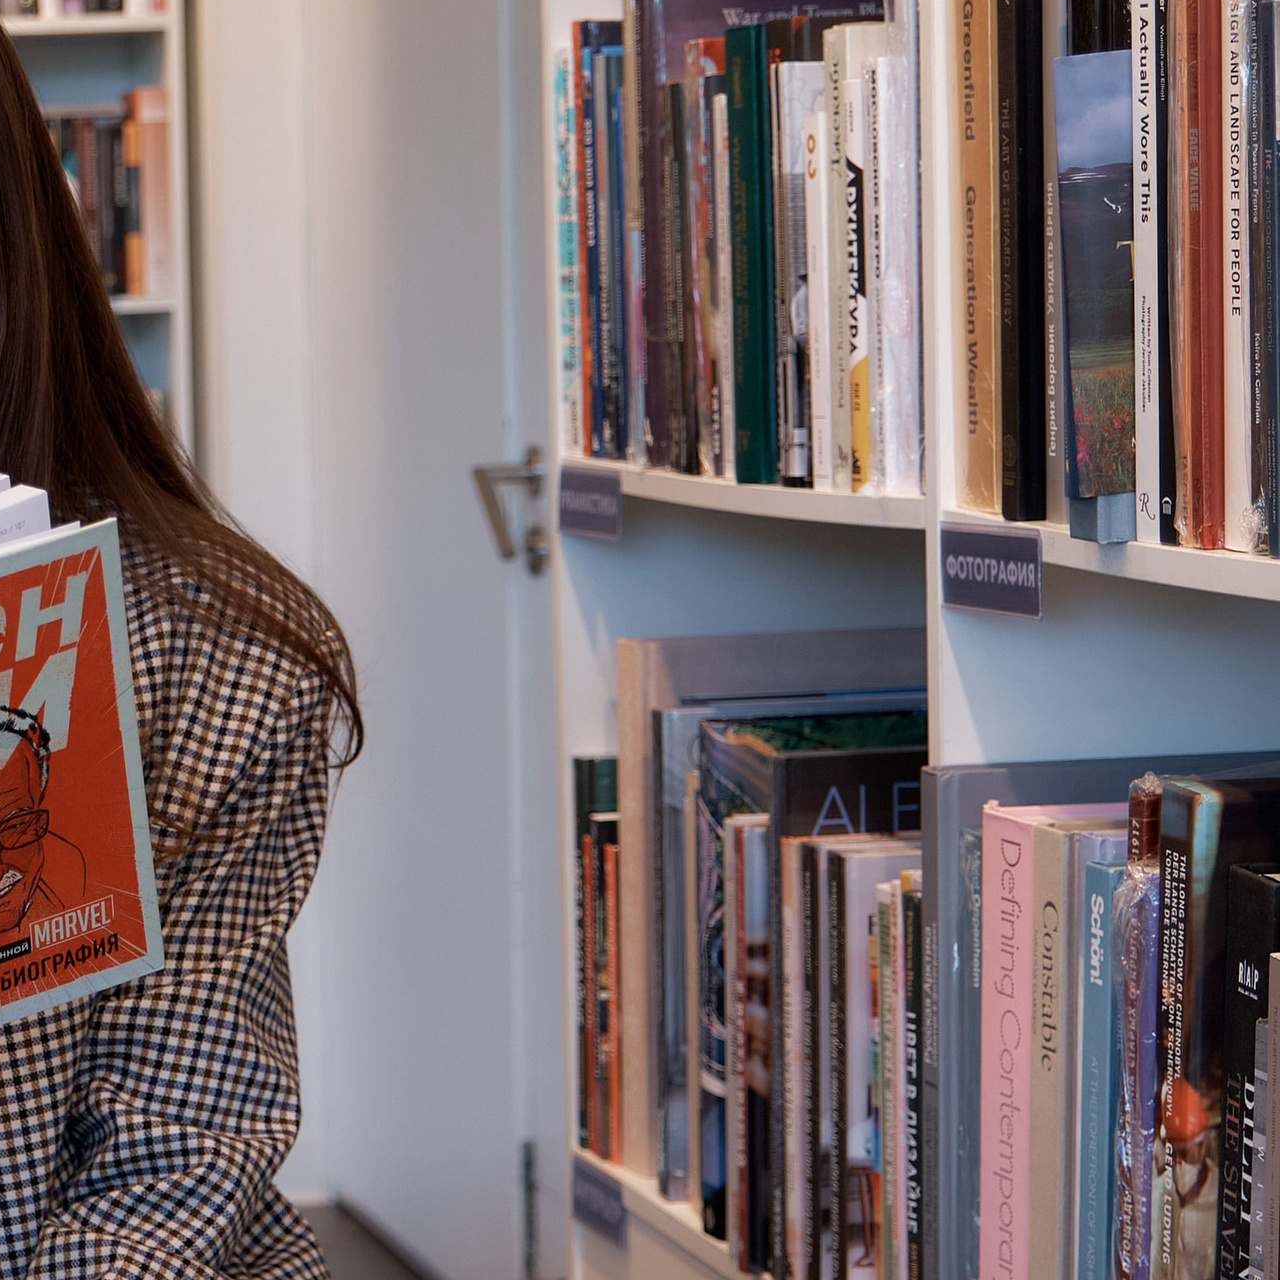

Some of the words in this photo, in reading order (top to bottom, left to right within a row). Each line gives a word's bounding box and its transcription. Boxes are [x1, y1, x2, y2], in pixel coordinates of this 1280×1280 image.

[1250, 0, 1258, 18] Art
[1250, 19, 1258, 40] and
[1138, 16, 1150, 107] Actually
[1158, 24, 1166, 58] Wunsch
[1229, 50, 1239, 86] AND
[962, 0, 975, 142] Greenfield
[1158, 77, 1166, 101] Elliott
[1251, 62, 1259, 128] Performative
[1001, 99, 1010, 129] THE
[1001, 133, 1010, 163] ART
[1140, 113, 1150, 173] Wore
[1188, 127, 1199, 163] FACE
[1230, 93, 1240, 201] LANDSCAPE
[1264, 147, 1273, 170] jfk
[1001, 169, 1011, 191] OF
[1140, 178, 1151, 224] This
[1189, 166, 1199, 212] VALUE
[1252, 188, 1260, 223] France
[1001, 197, 1012, 268] SHEPARD
[1230, 208, 1240, 240] FOR
[1263, 188, 1273, 292] photographic
[845, 166, 859, 355] АРХИТЕКТУРА
[965, 185, 978, 335] Generation
[1231, 248, 1241, 316] PEOPLE
[1002, 273, 1013, 327] FAIREY
[1265, 296, 1273, 355] memoir
[1047, 323, 1056, 396] Боровик
[1146, 338, 1152, 349] by
[1254, 362, 1261, 376] M.
[966, 340, 978, 435] Wealth
[1047, 400, 1057, 457] Генрих
[946, 554, 1036, 588] ФОТОГРАФИЯ
[1179, 855, 1187, 879] THE
[33, 900, 112, 949] MARVEL
[993, 837, 1022, 1000] Defining
[1163, 908, 1170, 925] DE
[1170, 881, 1178, 924] LANGE
[1178, 882, 1186, 919] LONG
[0, 933, 120, 993] БИОГРАФИЯ
[971, 893, 981, 988] Oppenheim
[1090, 893, 1105, 987] Schön!
[1168, 928, 1177, 997] SCHATTEN
[1177, 922, 1185, 981] SHADOW
[1041, 900, 1059, 1072] Constable
[1161, 928, 1170, 1012] TCHERNOBYL
[1175, 983, 1183, 1000] OF
[1168, 997, 1176, 1025] VON
[905, 1010, 917, 1079] ЦВЕТ
[1090, 1055, 1098, 1074] AT
[1173, 1003, 1182, 1080] CHERNOBYL
[905, 1083, 917, 1100] В
[1090, 1079, 1098, 1111] THE
[1166, 1026, 1175, 1118] TSCHERNOBYL
[1224, 1071, 1240, 1153] THE
[905, 1107, 920, 1234] ДИЗАЙНЕ
[1087, 1112, 1098, 1206] FOREFRONT
[1163, 1142, 1174, 1189] GERD
[1087, 1210, 1096, 1232] OF
[1162, 1194, 1172, 1266] LUDWIG
